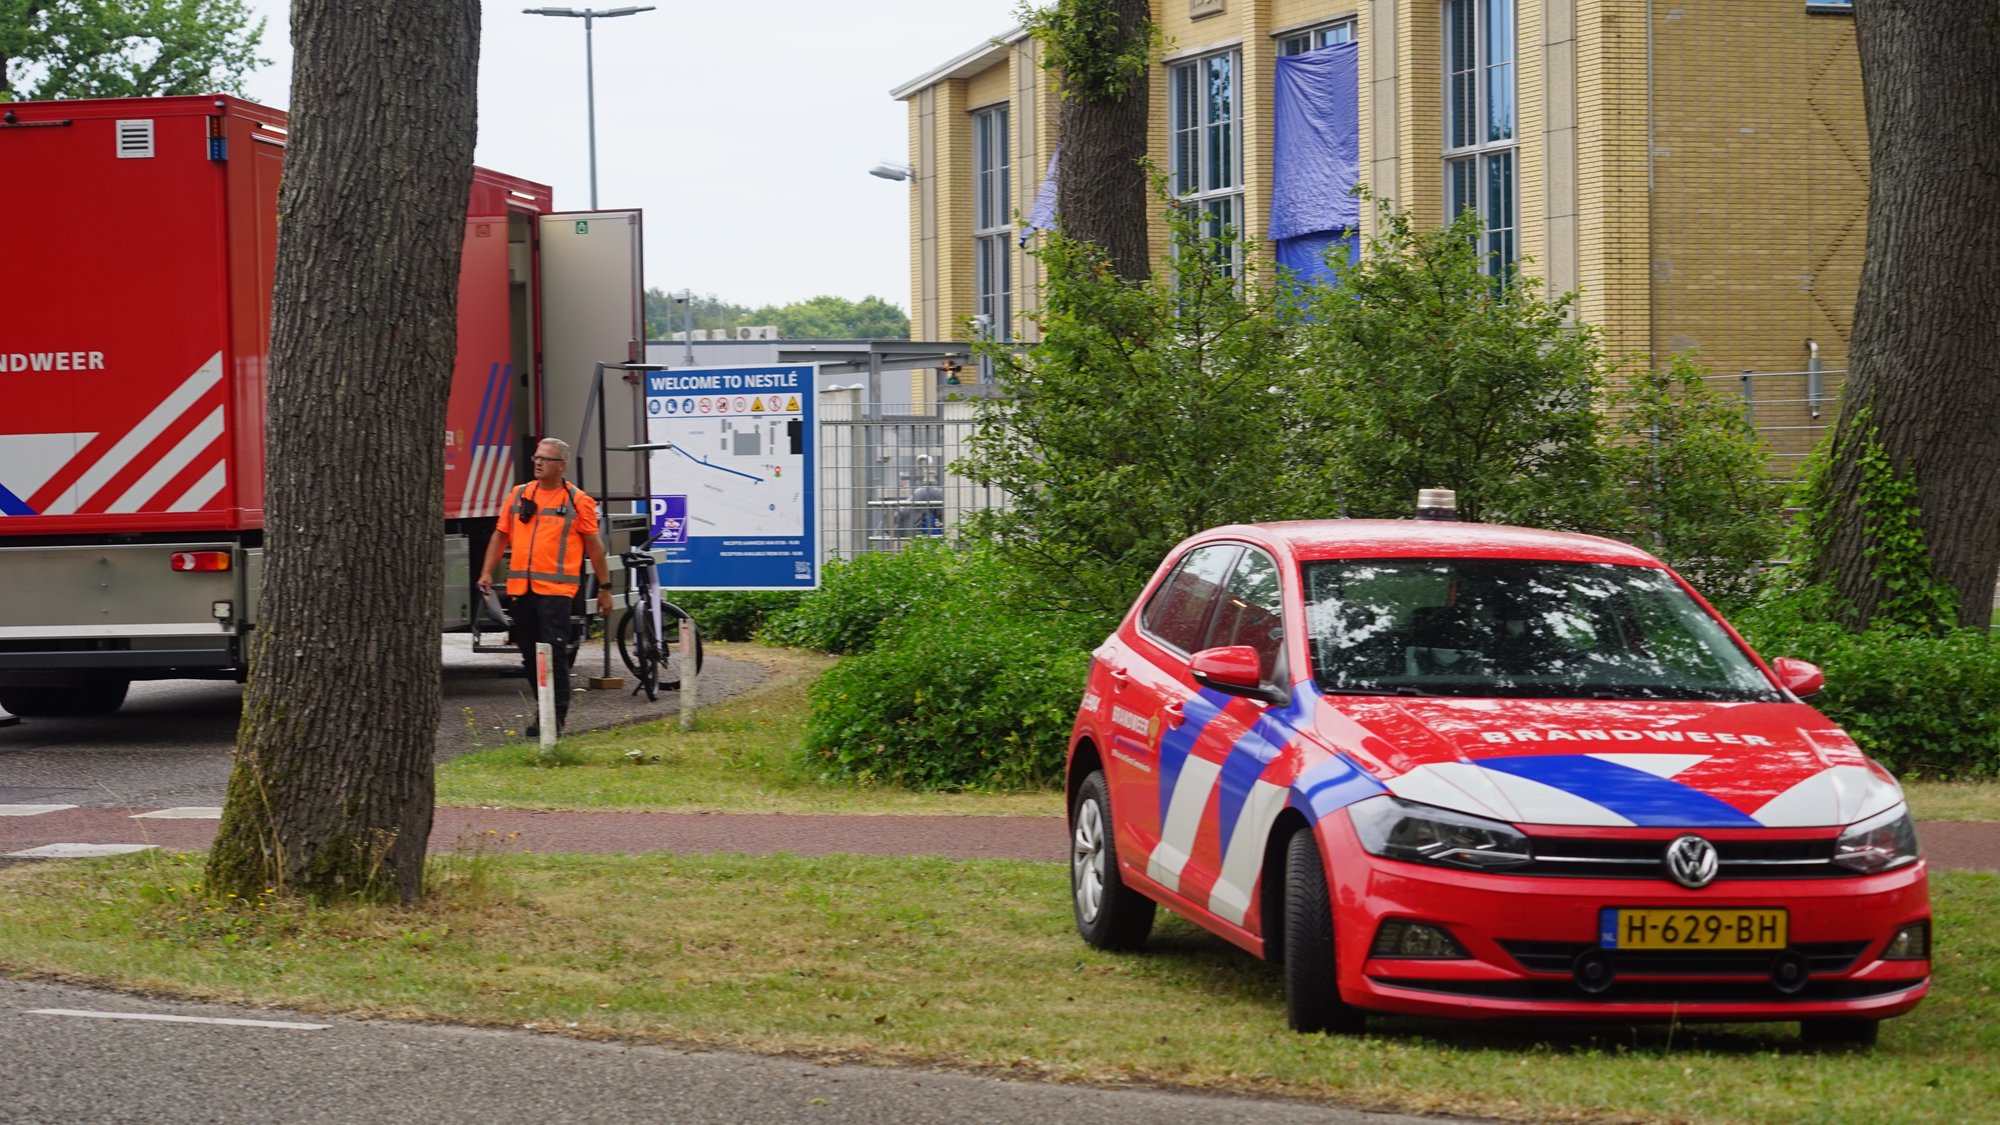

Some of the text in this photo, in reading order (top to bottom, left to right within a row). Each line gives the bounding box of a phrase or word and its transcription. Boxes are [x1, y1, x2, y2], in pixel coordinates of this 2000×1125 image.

[651, 371, 798, 390] WELCOME TO NESTLÉ
[650, 499, 668, 525] P
[1480, 729, 1773, 746] BRANDWEER
[1602, 932, 1616, 942] NL
[1627, 915, 1777, 944] H-629-BH
